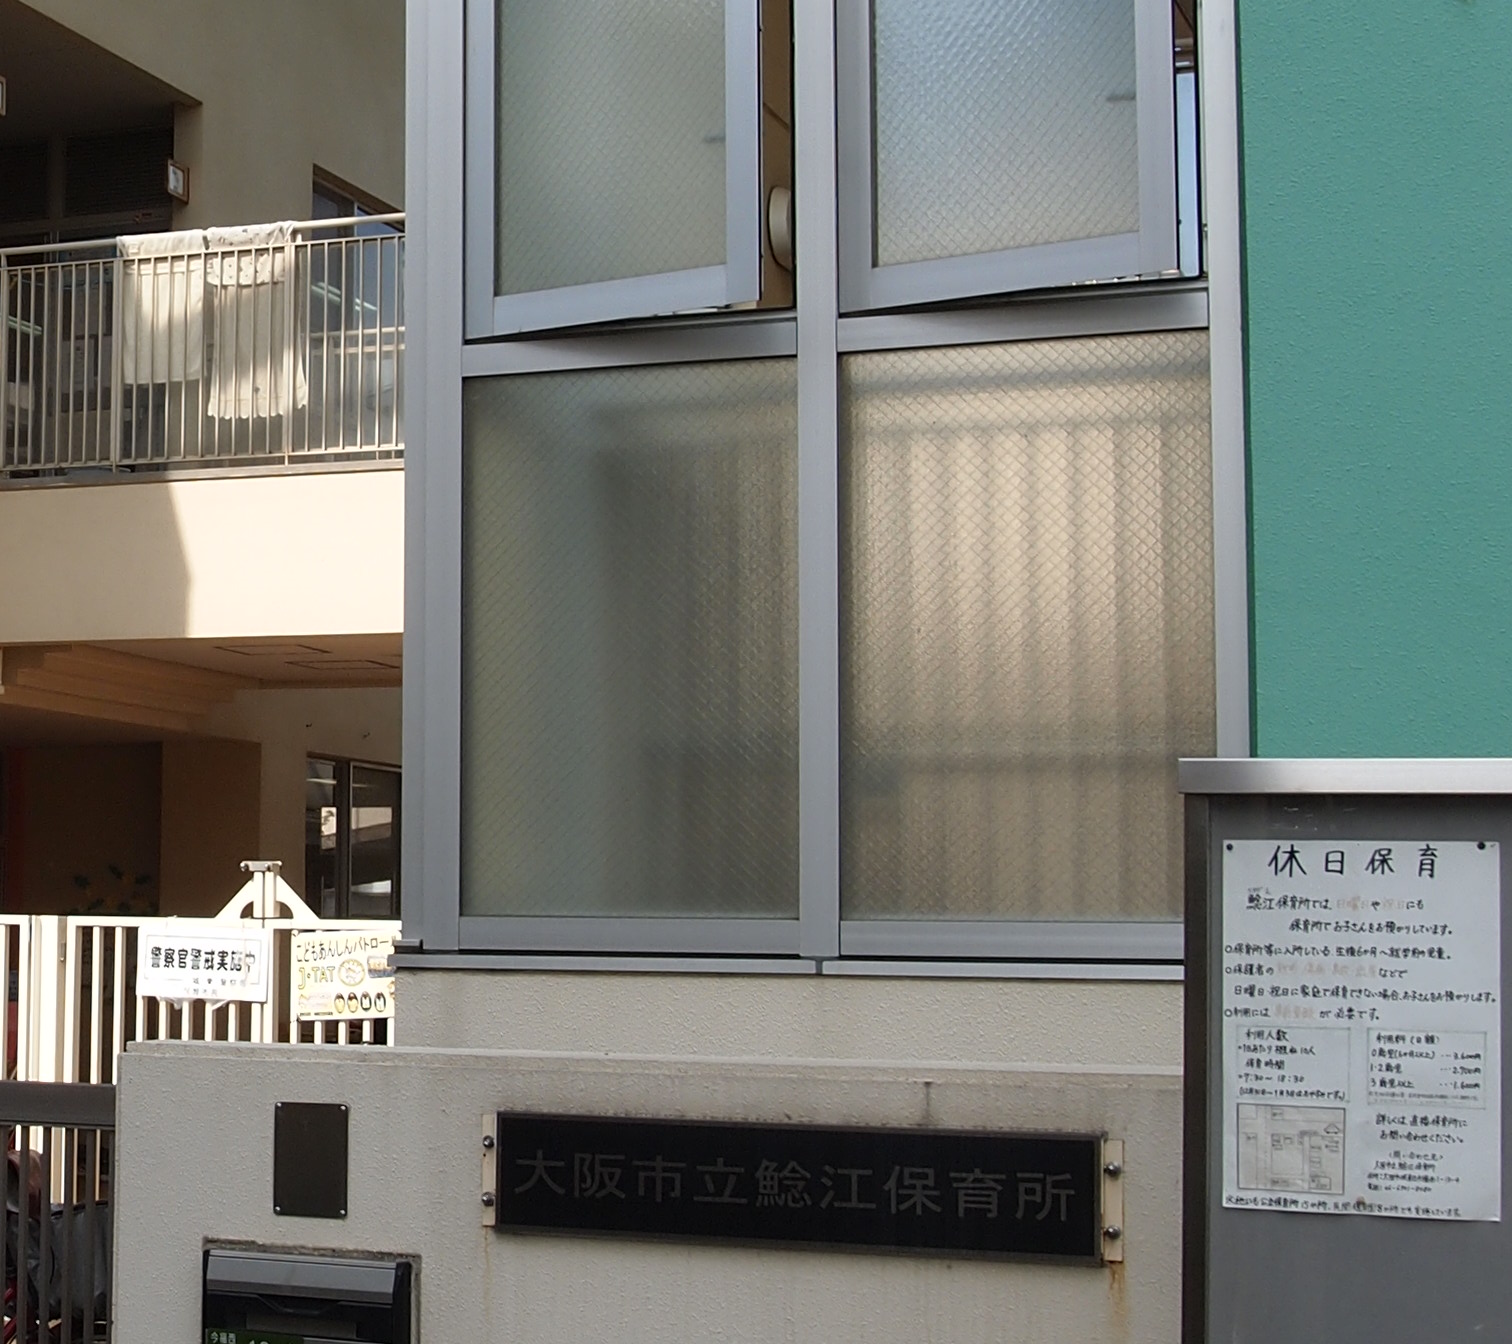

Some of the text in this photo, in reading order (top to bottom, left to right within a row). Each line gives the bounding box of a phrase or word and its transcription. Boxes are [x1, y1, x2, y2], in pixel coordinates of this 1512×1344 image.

[1268, 843, 1438, 879] 休日保育
[150, 946, 256, 973] 警察官警戒実施中
[513, 1148, 1076, 1223] 大阪市立鯰江保育所
